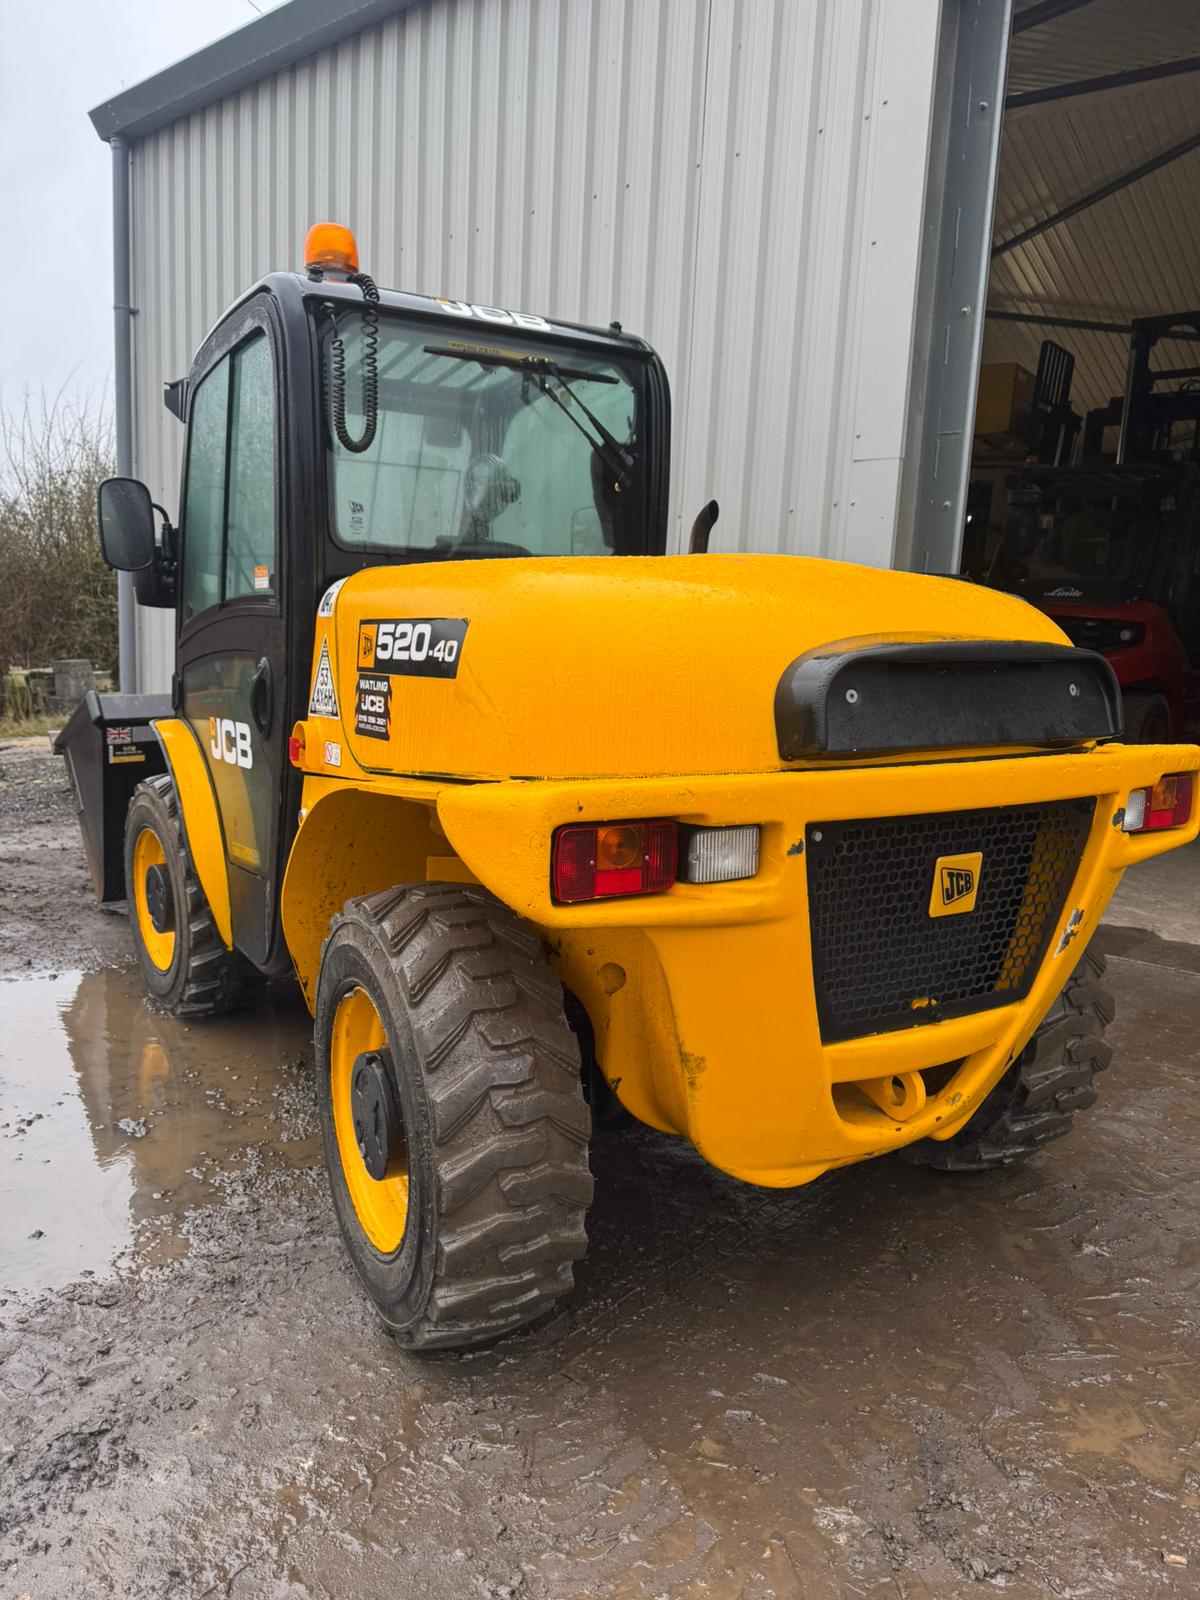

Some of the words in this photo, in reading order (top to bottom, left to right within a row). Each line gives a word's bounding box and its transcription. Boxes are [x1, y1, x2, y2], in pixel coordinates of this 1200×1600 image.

[436, 298, 551, 331] JCB
[362, 634, 373, 656] JCB
[376, 623, 458, 662] 520-40
[359, 679, 388, 693] WATLING
[361, 694, 385, 713] JCB
[209, 716, 253, 769] JCB
[945, 871, 972, 901] JCB
